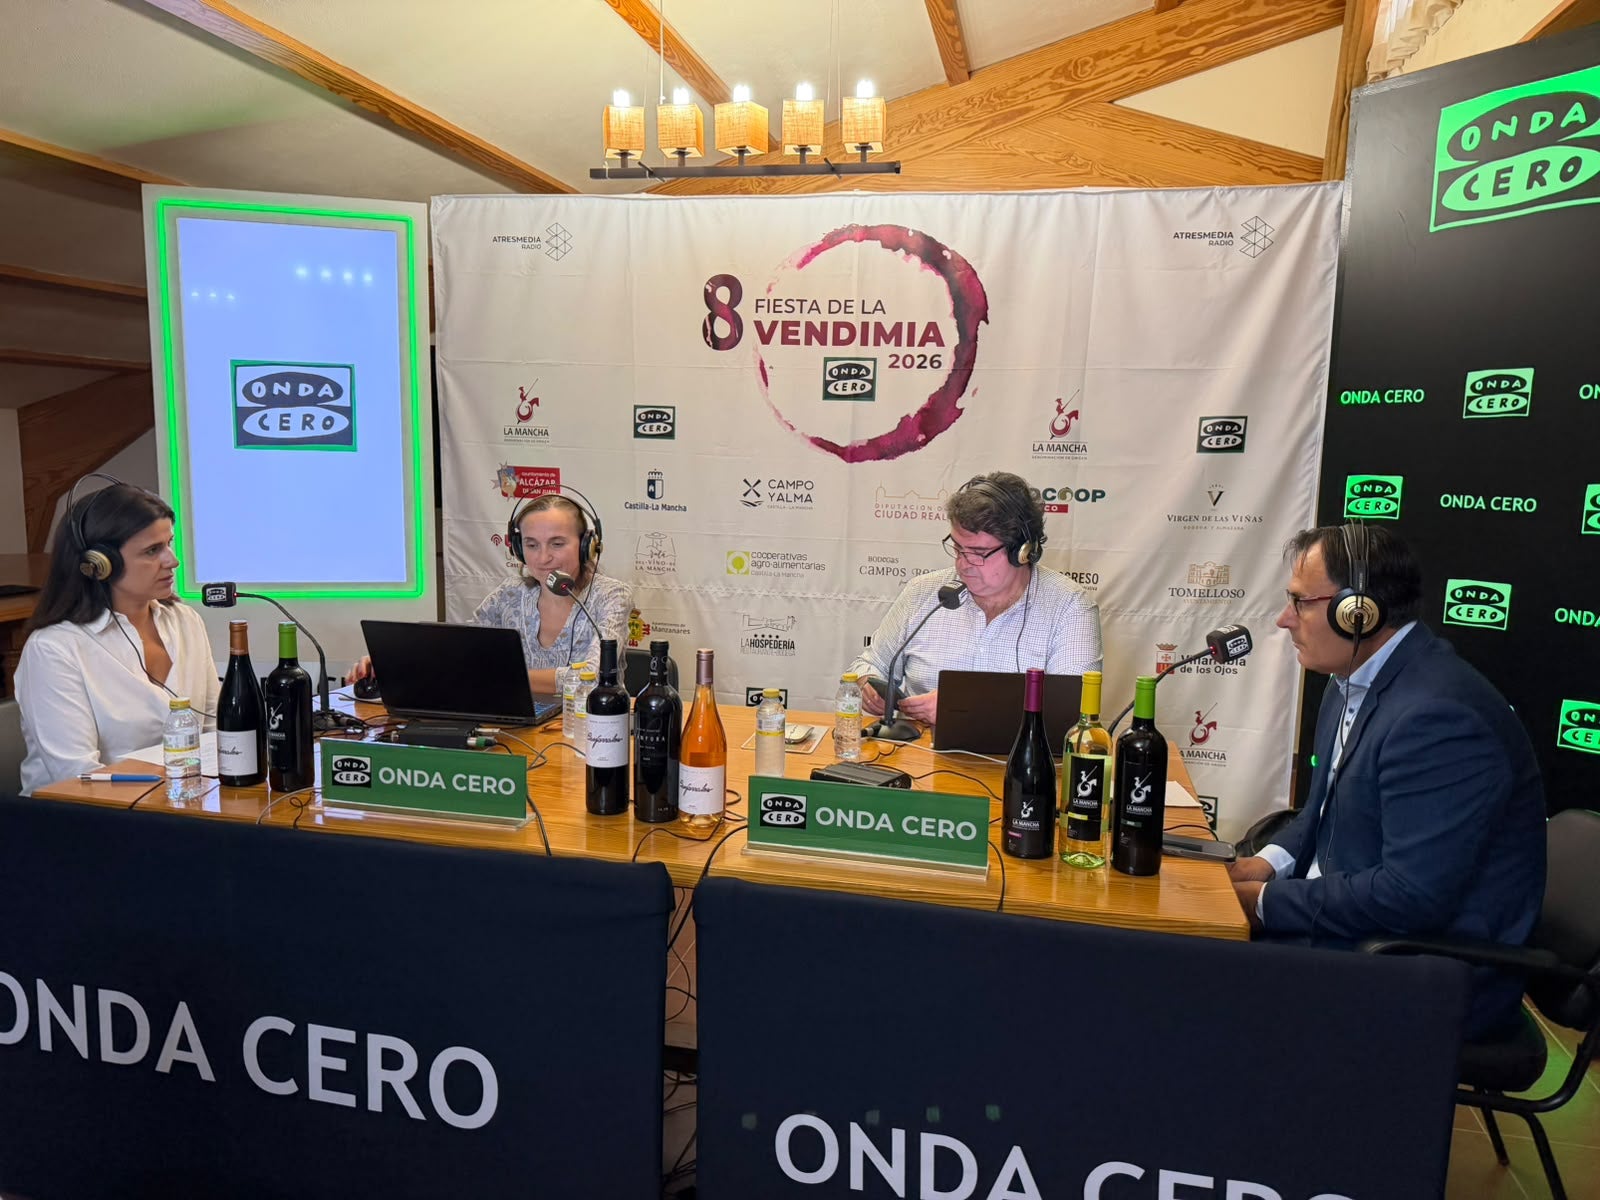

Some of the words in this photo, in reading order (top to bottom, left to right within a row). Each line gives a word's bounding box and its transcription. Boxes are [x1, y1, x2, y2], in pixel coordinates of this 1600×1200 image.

[1461, 102, 1587, 151] ONDA
[1463, 156, 1583, 201] CERO
[492, 236, 542, 244] ATRESMEDIA
[1173, 231, 1234, 240] ATRESMEDIA
[702, 273, 744, 351] 8
[755, 299, 821, 315] FIESTA
[828, 299, 855, 315] DE
[861, 300, 887, 315] LA
[753, 320, 946, 348] VENDIMIA
[888, 354, 942, 370] 2026
[832, 367, 868, 378] ONDA
[251, 381, 335, 398] ONDA
[833, 382, 867, 392] CERO
[1475, 379, 1521, 391] ONDA
[1340, 391, 1380, 405] ONDA
[1384, 389, 1425, 404] CERO
[1476, 398, 1520, 409] CERO
[258, 413, 335, 431] CERO
[640, 413, 668, 421] ONDA
[503, 427, 513, 436] LA
[514, 427, 549, 437] MANCHA
[642, 424, 668, 433] CERO
[1206, 423, 1239, 433] ONDA
[1207, 437, 1238, 446] CERO
[1032, 443, 1044, 452] LA
[1046, 443, 1088, 453] MANCHA
[519, 477, 556, 487] ALCÁZAR
[768, 479, 814, 491] CAMPO
[1354, 484, 1393, 494] ONDA
[768, 492, 813, 503] YALMA
[1440, 494, 1486, 510] ONDA
[1490, 497, 1537, 512] CERO
[624, 501, 660, 510] Castilla-La
[661, 503, 687, 512] Mancha
[874, 503, 933, 511] DIPUTACIÓN
[1355, 501, 1391, 511] CERO
[874, 510, 918, 520] CIUDAD
[921, 512, 947, 521] REAL
[1167, 514, 1200, 522] VIRGEN
[1232, 514, 1263, 523] VIÑAS
[751, 551, 808, 561] cooperativas
[1168, 587, 1246, 599] TOMELLOSO
[1455, 589, 1500, 602] ONDA
[1456, 607, 1499, 621] CERO
[651, 625, 691, 635] Manzanares
[1180, 665, 1192, 674] de
[1196, 665, 1211, 674] los
[1214, 665, 1238, 675] Ojos
[1186, 751, 1227, 761] MANCHA
[337, 760, 366, 770] ONDA
[338, 774, 366, 782] CERO
[378, 766, 446, 790] ONDA
[452, 773, 516, 795] CERO
[766, 800, 800, 809] ONDA
[768, 813, 800, 823] CERO
[815, 807, 894, 833] ONDA
[901, 815, 977, 841] CERO
[0, 970, 215, 1083] ONDA
[242, 1015, 499, 1129] CERO
[774, 1113, 1044, 1200] ONDA
